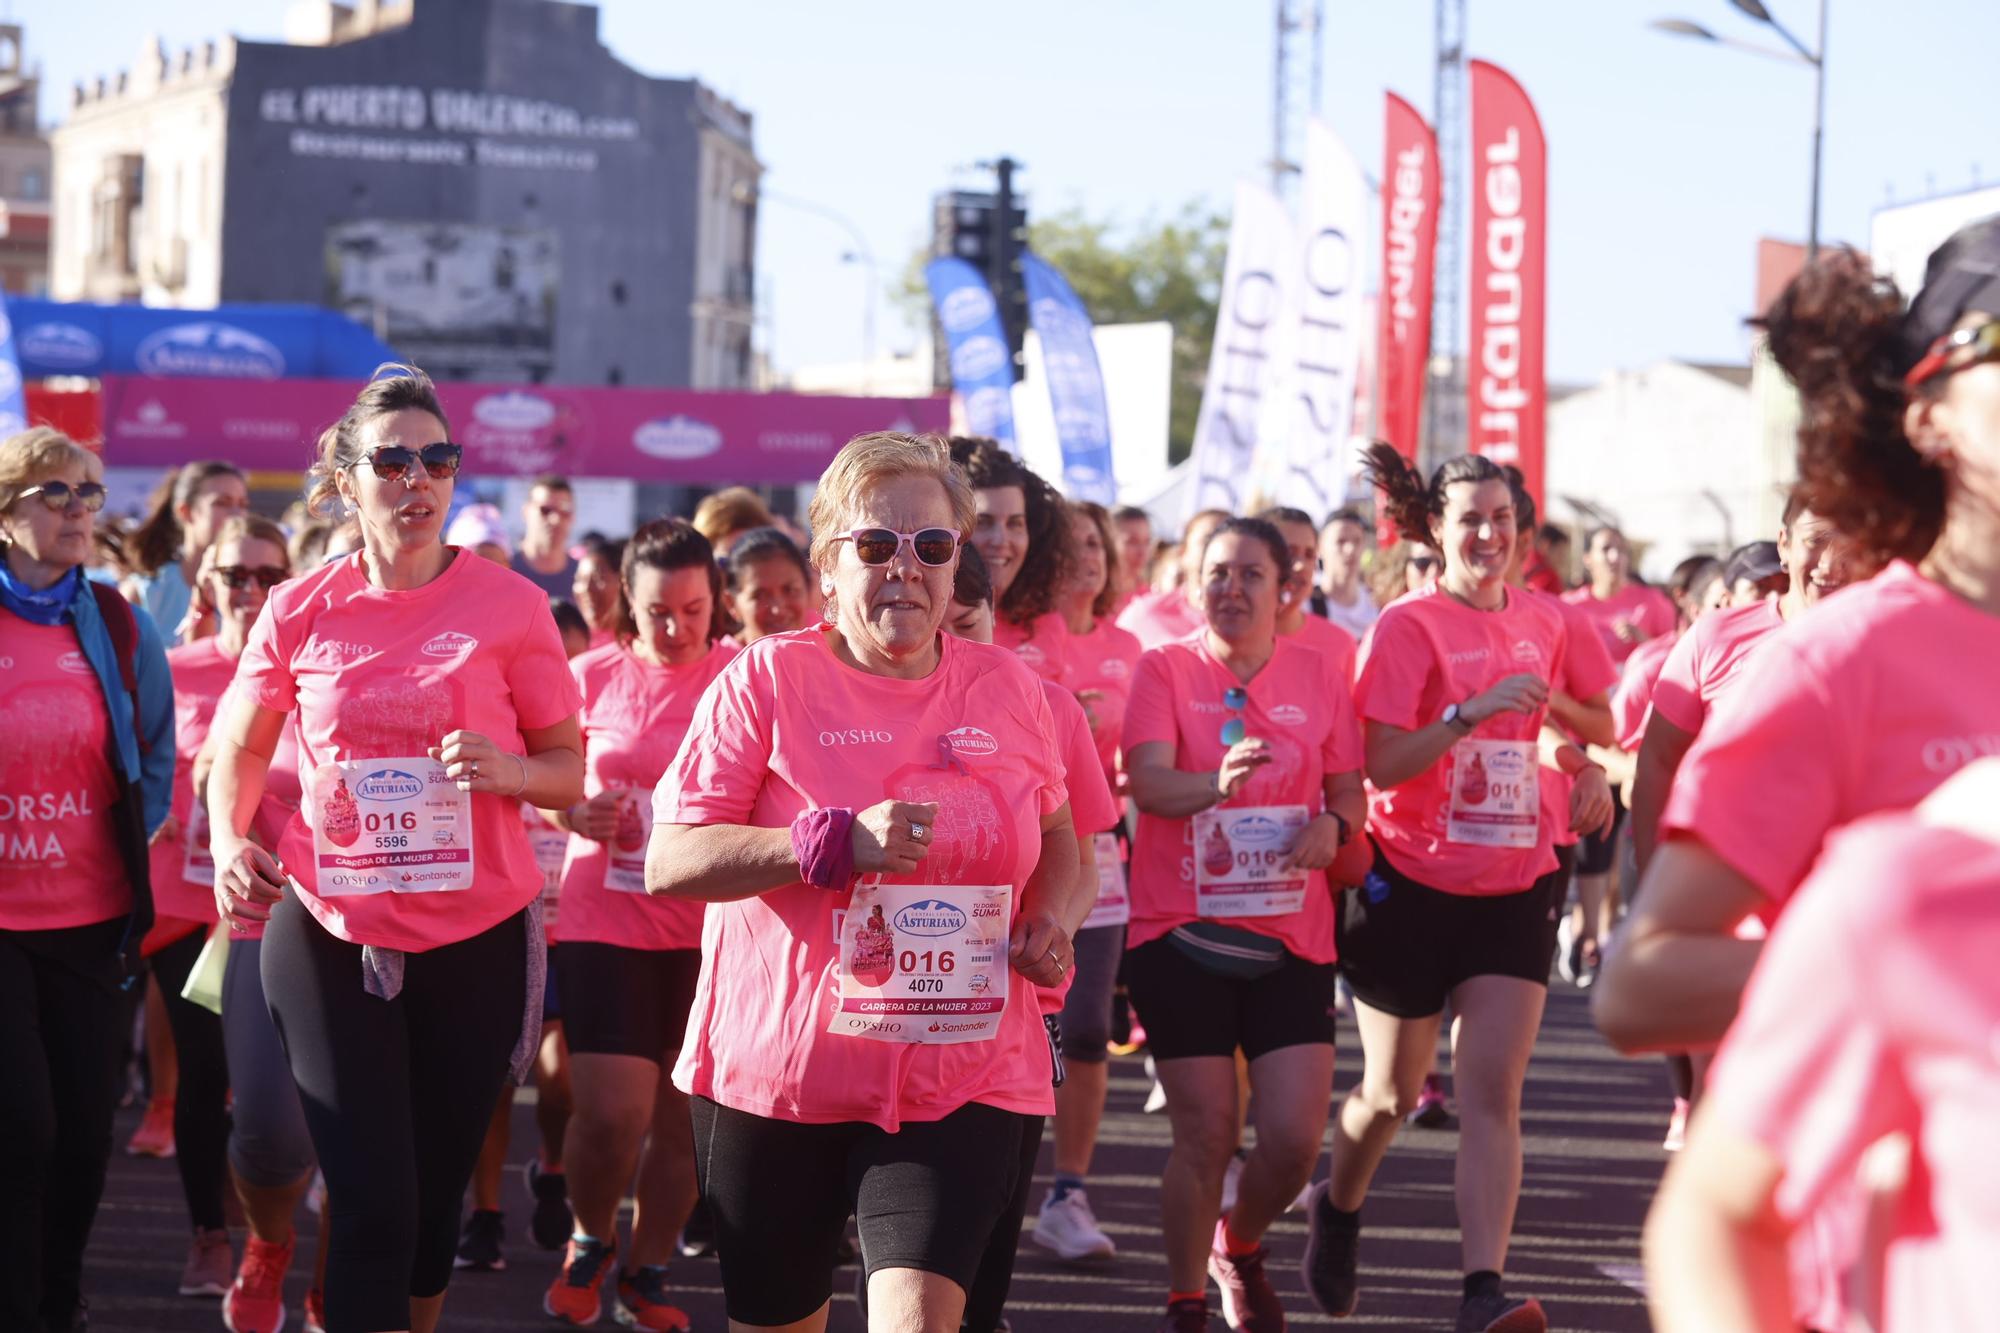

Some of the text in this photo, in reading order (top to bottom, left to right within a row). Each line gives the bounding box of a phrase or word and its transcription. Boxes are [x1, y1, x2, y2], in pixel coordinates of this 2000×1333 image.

[304, 87, 427, 130] PUERTO
[819, 729, 892, 746] OYSHO
[362, 781, 418, 795] ASTURIANA
[1491, 783, 1521, 799] 016
[365, 812, 416, 831] 016
[375, 836, 408, 848] 5596
[335, 857, 374, 867] CARRERA
[389, 856, 401, 864] LA
[403, 853, 433, 863] MUJER
[436, 852, 457, 860] 2023
[1237, 850, 1277, 866] 016
[332, 875, 379, 886] OYSHO
[413, 871, 462, 882] Santander
[900, 912, 960, 928] ASTURIANA
[972, 908, 1001, 917] SUMA
[899, 950, 955, 973] 016
[908, 979, 943, 993] 4070
[860, 1002, 992, 1011] CARRERA DE LA MUJER 2023
[849, 1018, 902, 1033] OYSHO
[941, 1021, 989, 1033] Santander
